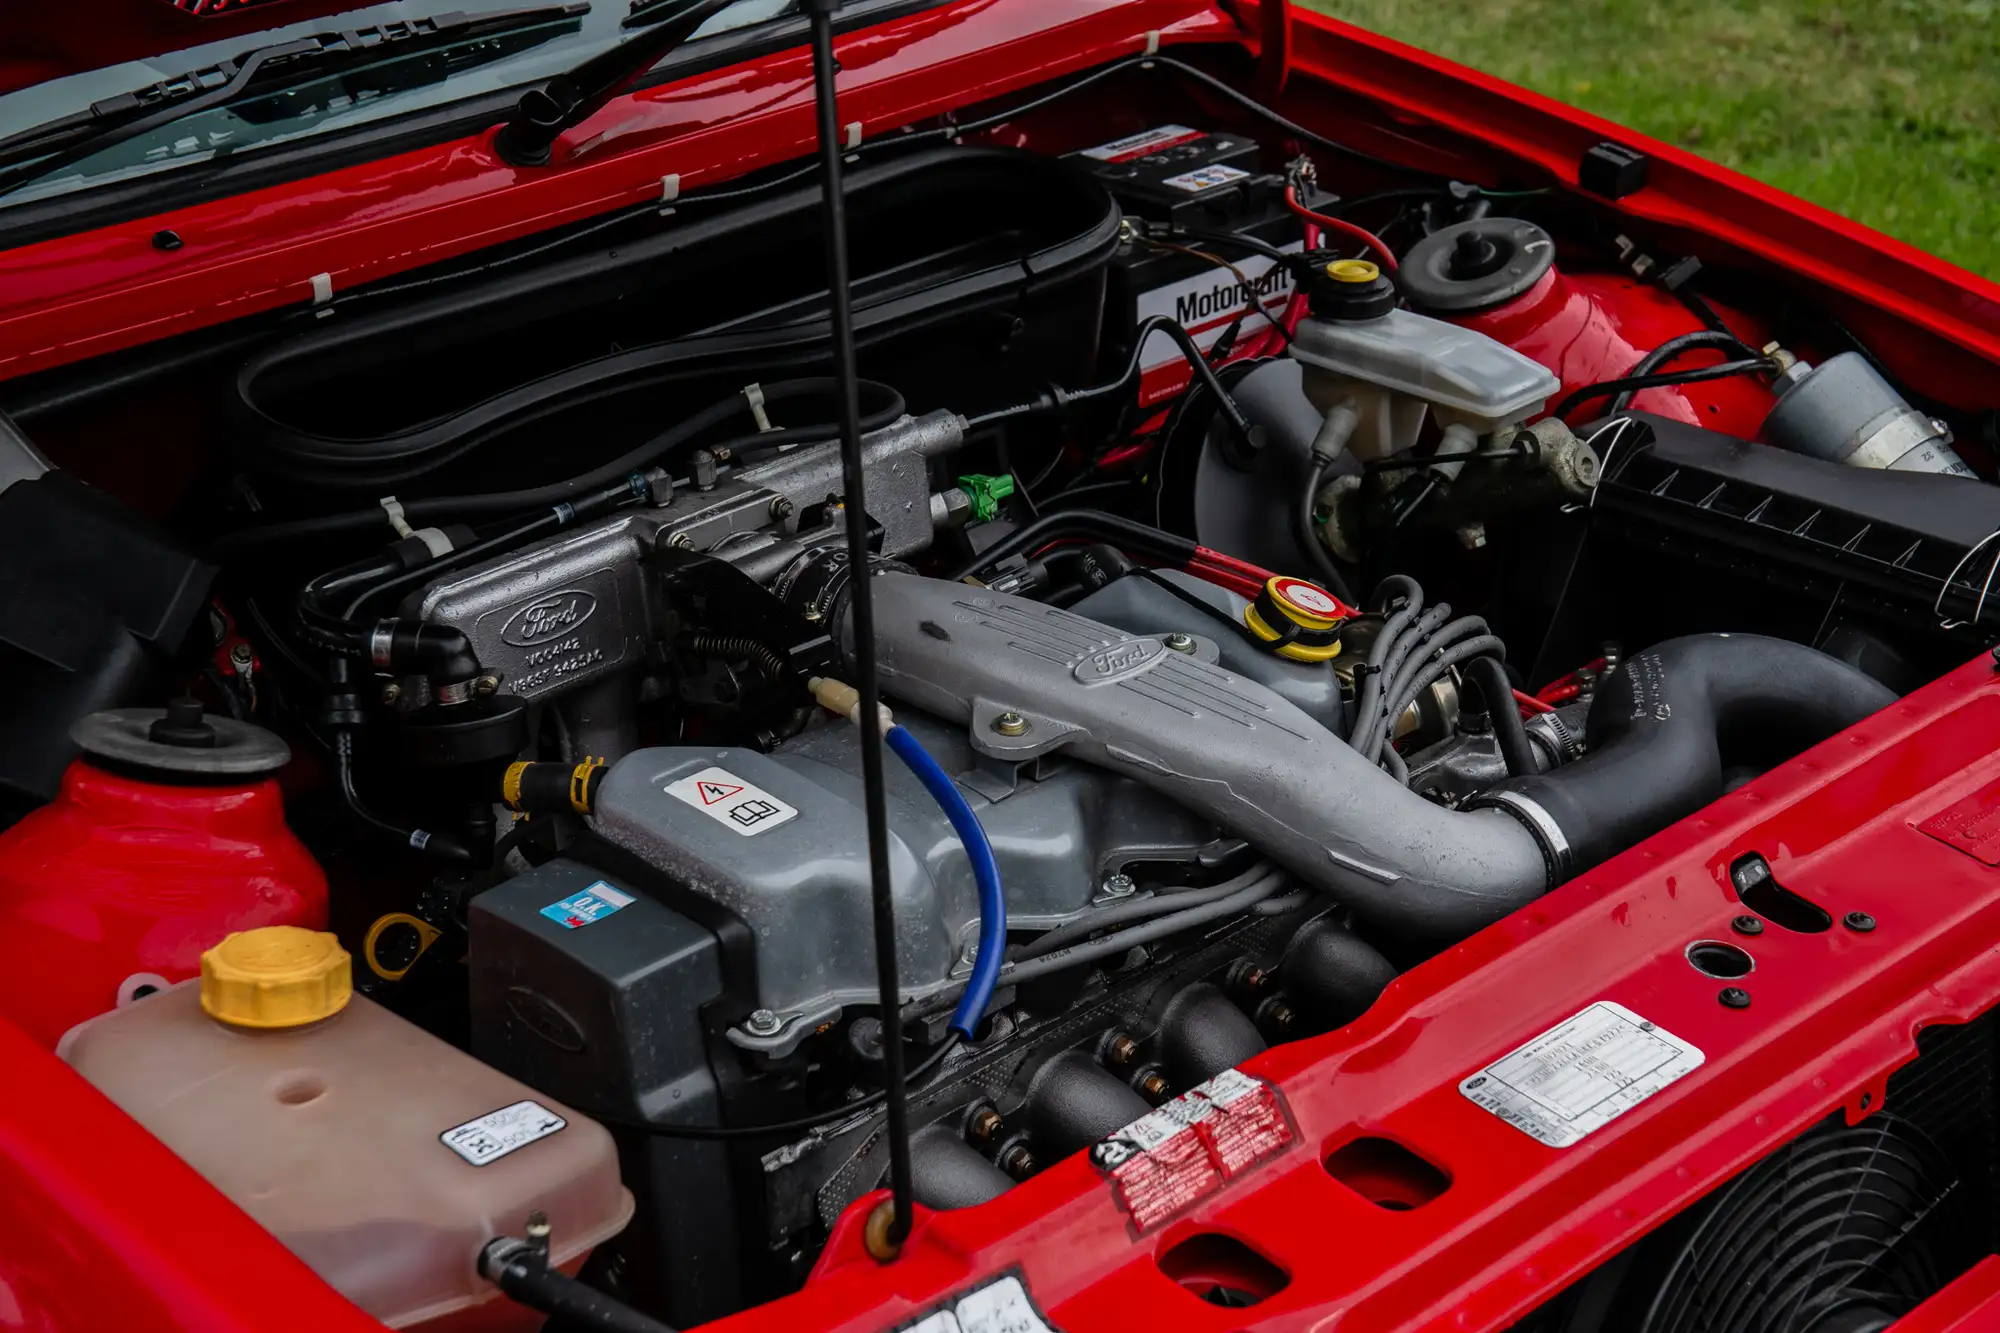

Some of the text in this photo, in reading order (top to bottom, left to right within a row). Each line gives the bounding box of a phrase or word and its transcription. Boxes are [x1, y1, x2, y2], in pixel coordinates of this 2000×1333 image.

[1921, 450, 1935, 462] 32
[521, 599, 578, 639] Ford
[1092, 643, 1150, 676] Ford
